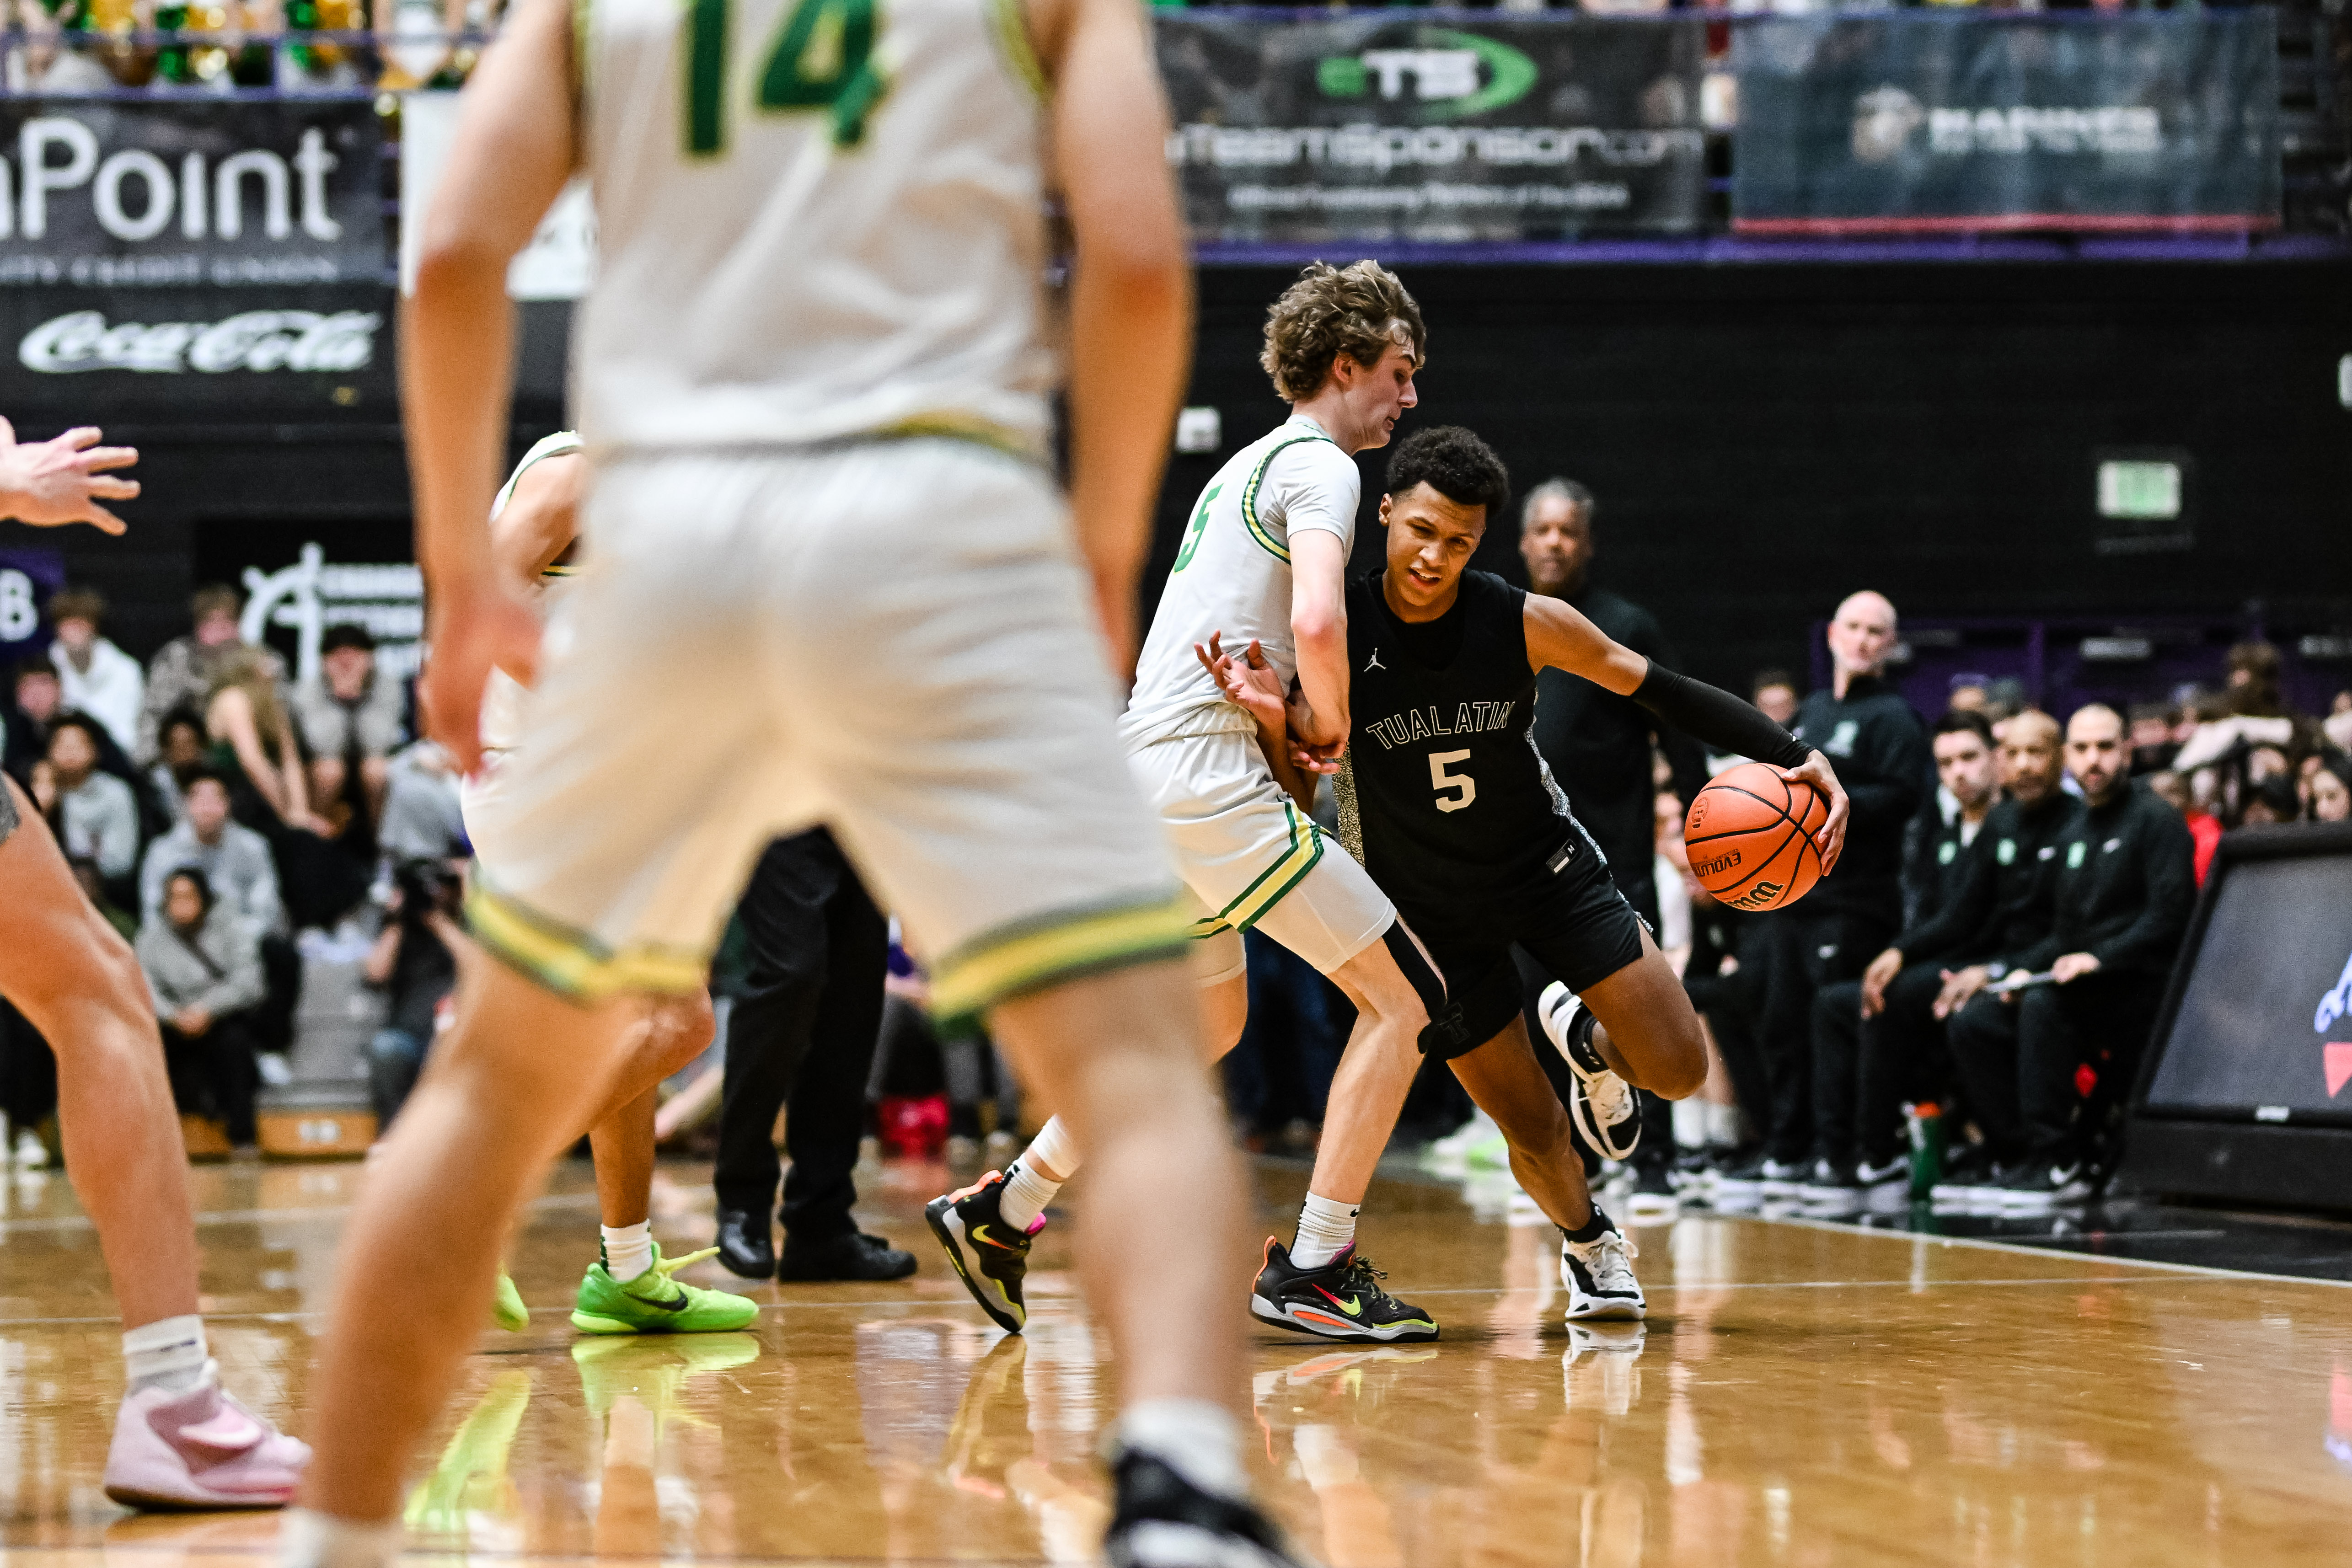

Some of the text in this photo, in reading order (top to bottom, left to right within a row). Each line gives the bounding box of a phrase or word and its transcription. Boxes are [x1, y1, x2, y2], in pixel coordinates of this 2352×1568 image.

[685, 0, 883, 151] 14
[0, 117, 343, 242] Point
[1366, 701, 1516, 750] TUALATIN
[1428, 749, 1476, 813] 5
[1567, 844, 1575, 855] M
